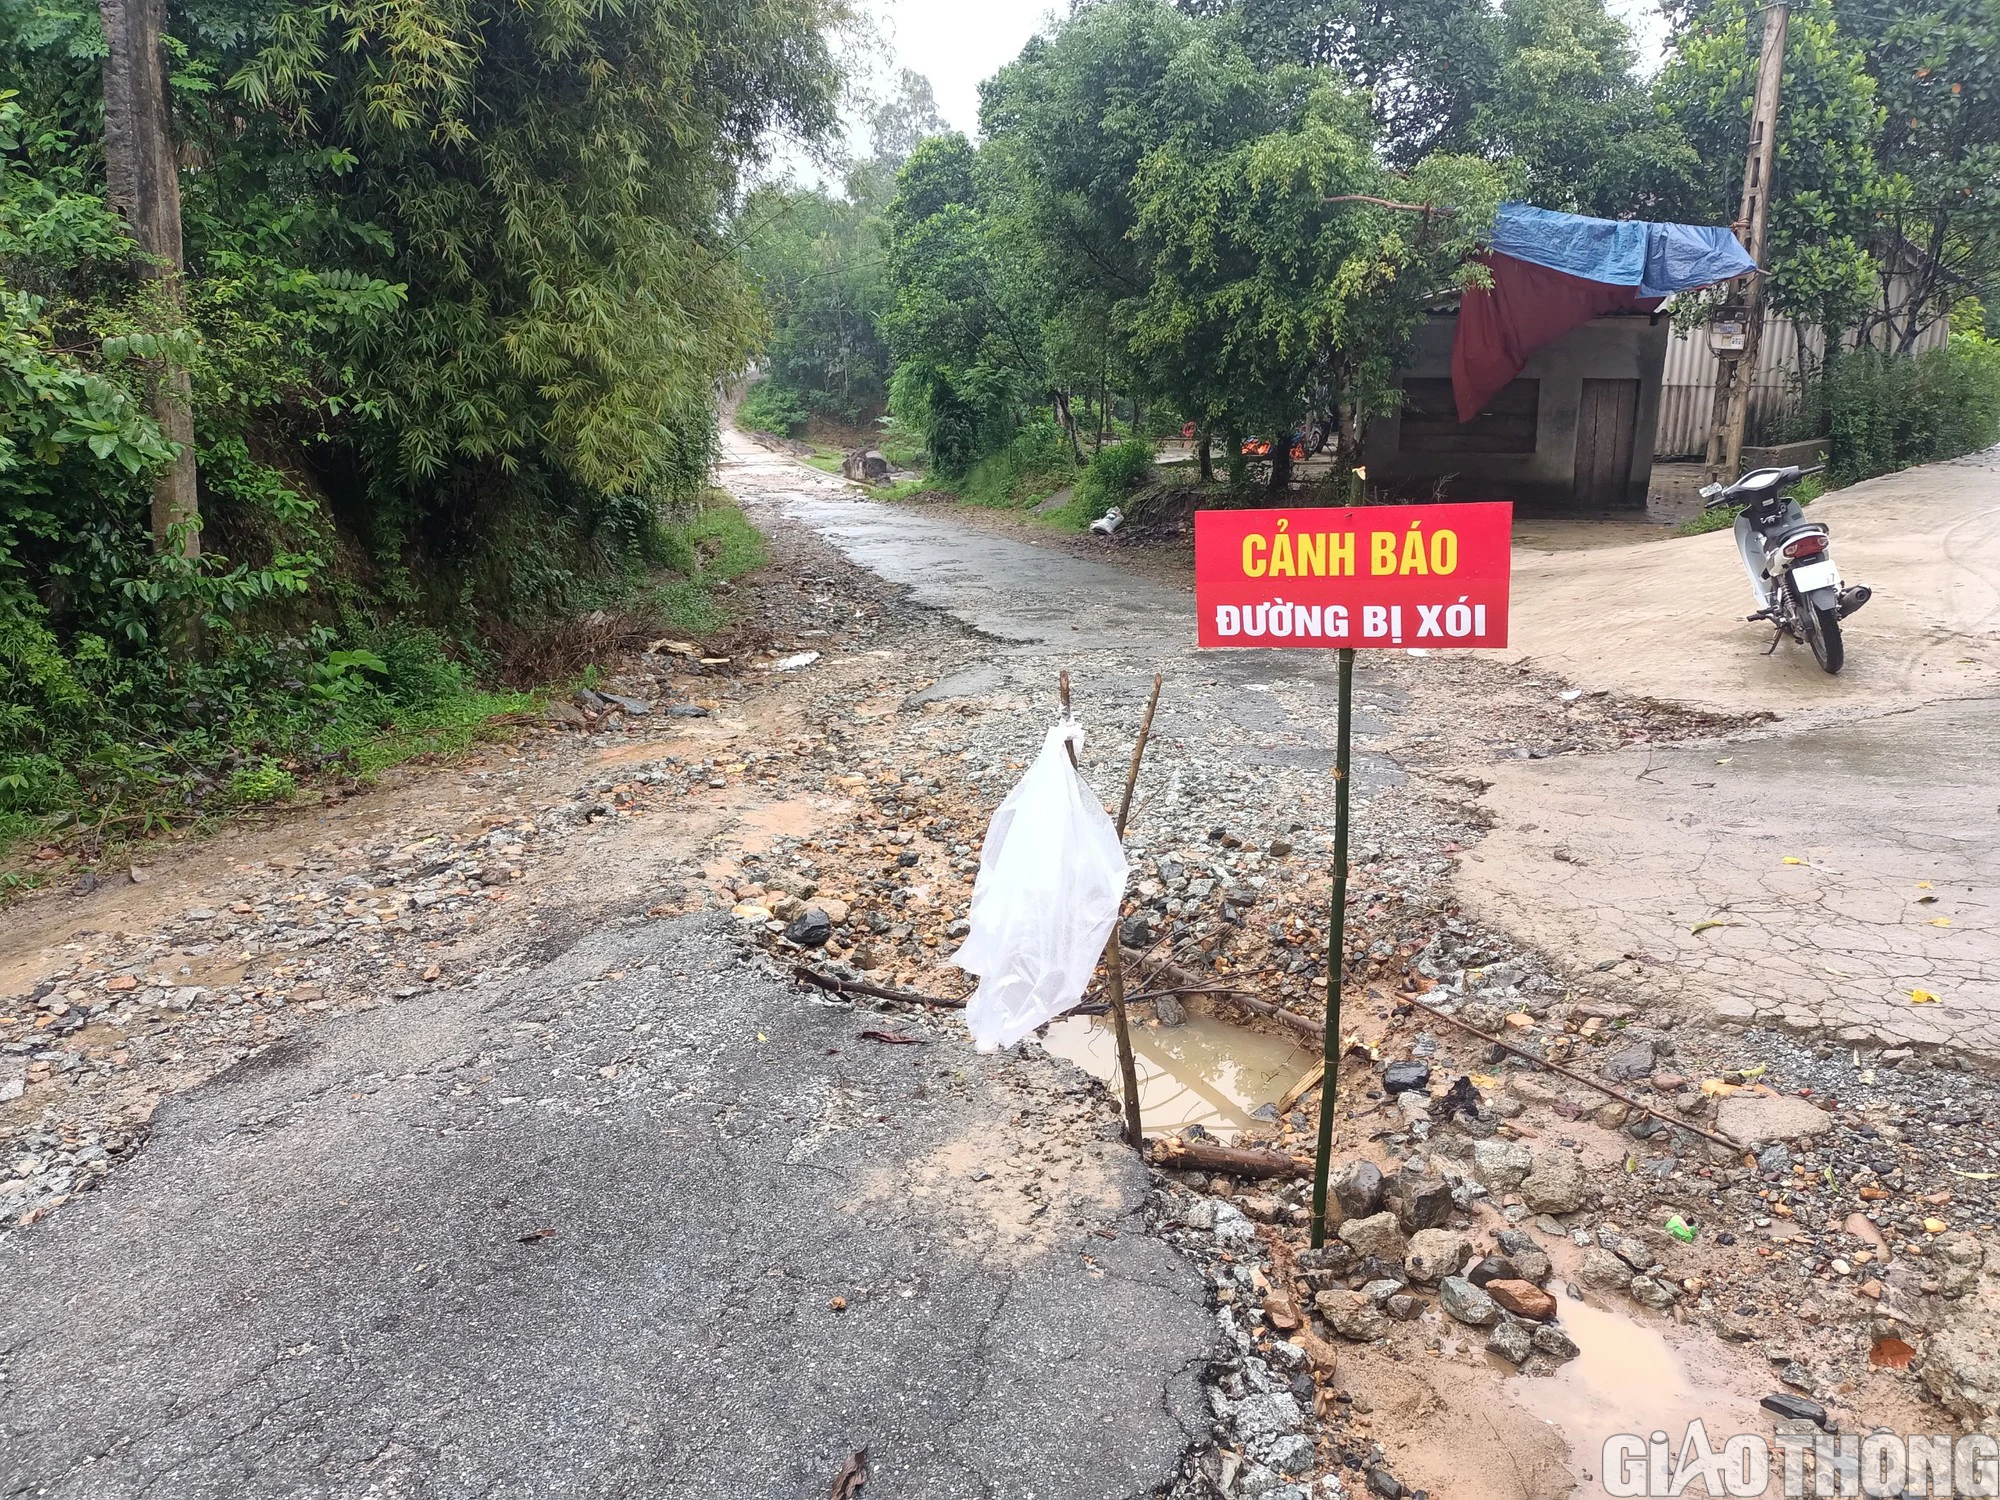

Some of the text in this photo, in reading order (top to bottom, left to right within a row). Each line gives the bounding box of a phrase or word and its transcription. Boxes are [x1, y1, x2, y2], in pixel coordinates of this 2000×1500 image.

[1242, 518, 1458, 577] CẢNH BÁO
[1216, 595, 1486, 643] ĐƯỜNG BỊ XÓI
